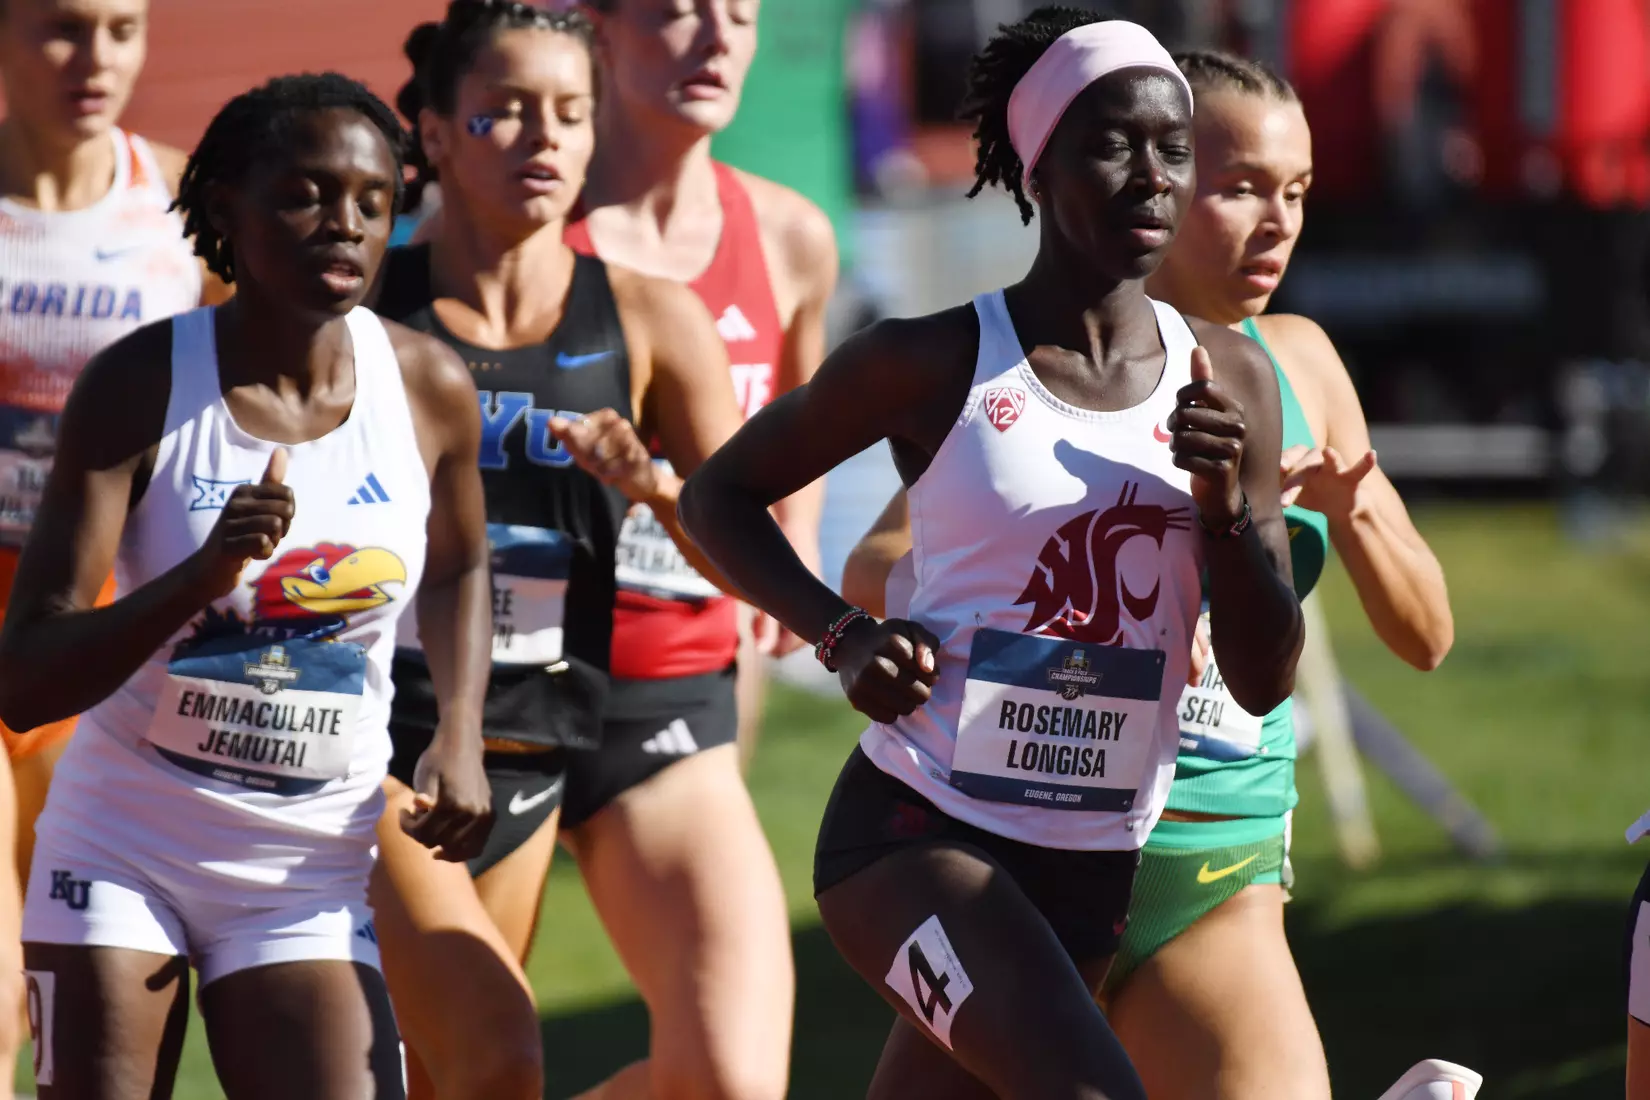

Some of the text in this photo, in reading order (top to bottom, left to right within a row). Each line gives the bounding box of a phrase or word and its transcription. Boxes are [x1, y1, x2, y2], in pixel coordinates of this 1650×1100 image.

[0, 281, 142, 320] ORIDA
[985, 388, 1025, 416] PAC
[993, 406, 1015, 425] 12
[1051, 672, 1097, 684] CHAMPIONSHIPS
[177, 690, 343, 736] EMMACULATE
[998, 700, 1128, 741] ROSEMARY
[1178, 695, 1225, 727] SEN
[197, 729, 307, 768] JEMUTAI
[1006, 740, 1106, 778] LONGISA
[1024, 788, 1082, 803] EUGENE, OREGON
[49, 870, 92, 910] KU
[908, 939, 953, 1028] 4
